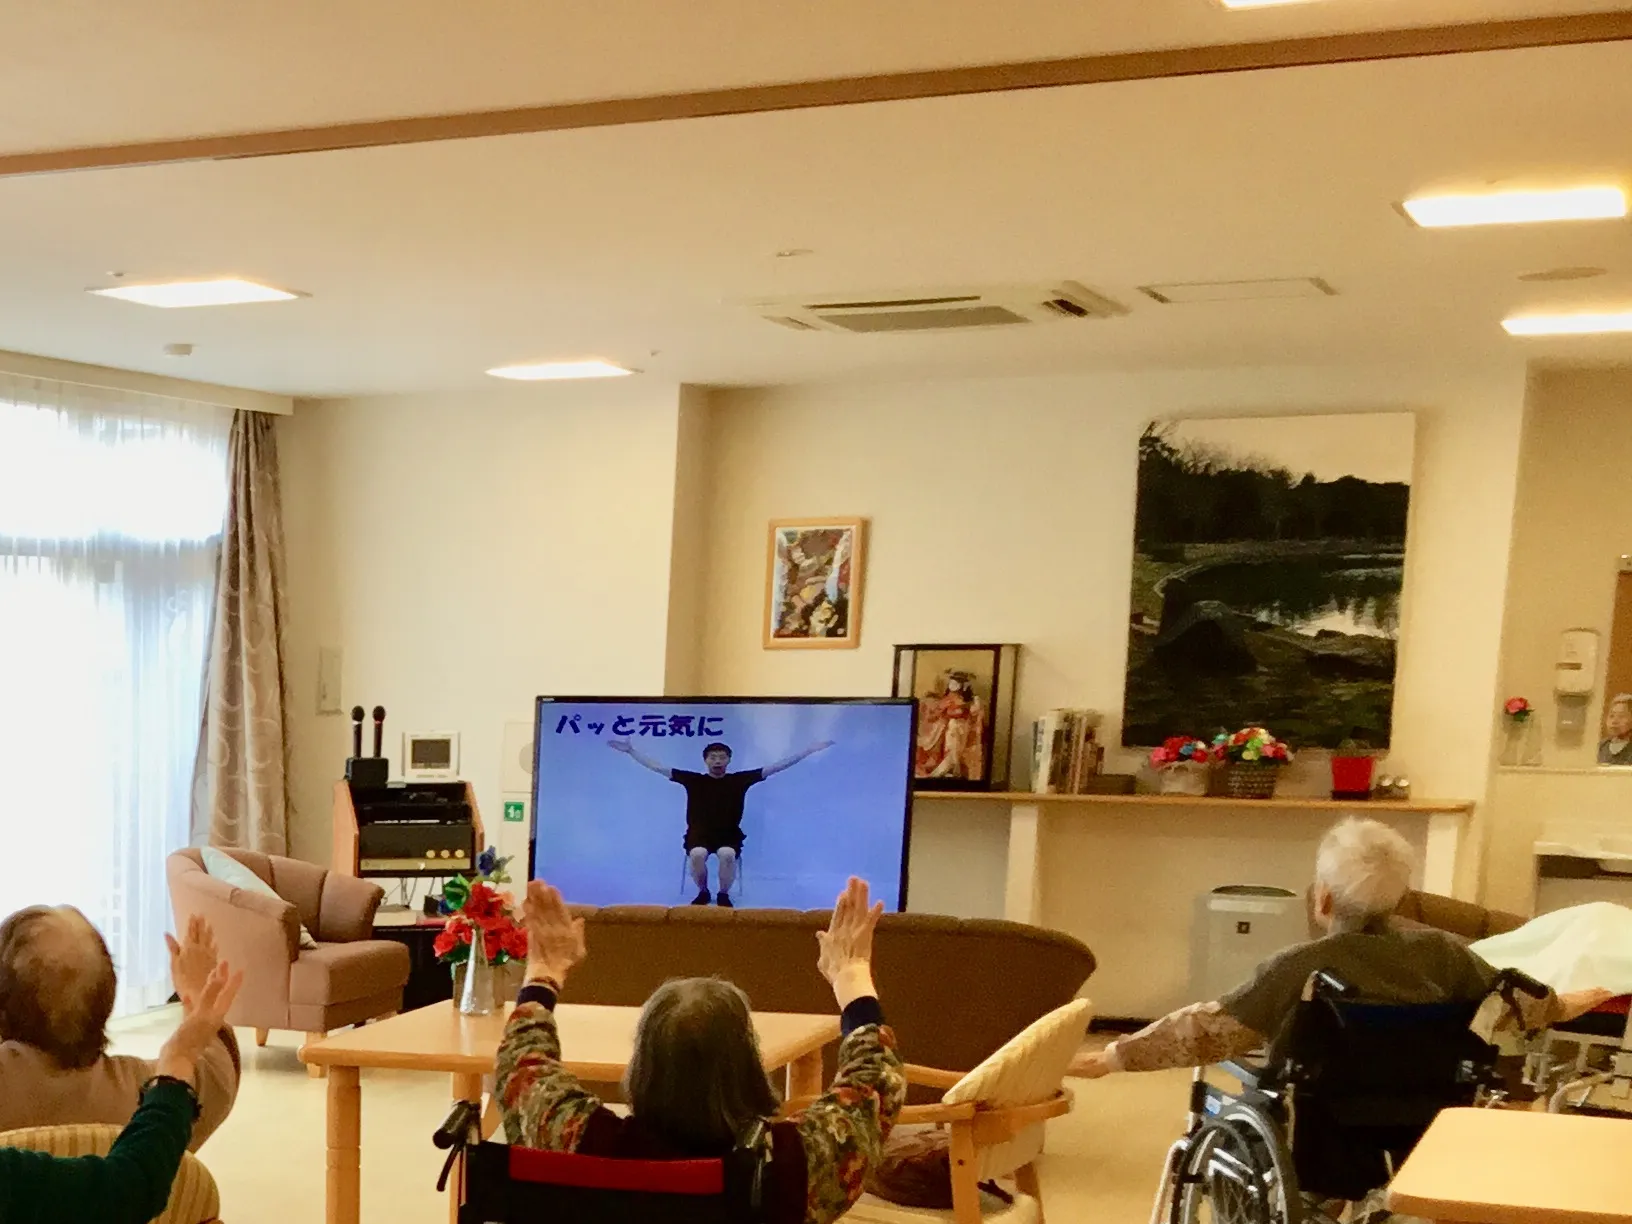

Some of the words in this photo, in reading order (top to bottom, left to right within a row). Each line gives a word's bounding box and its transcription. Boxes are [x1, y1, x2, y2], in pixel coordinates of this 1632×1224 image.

[555, 713, 724, 737] パッと元気に
